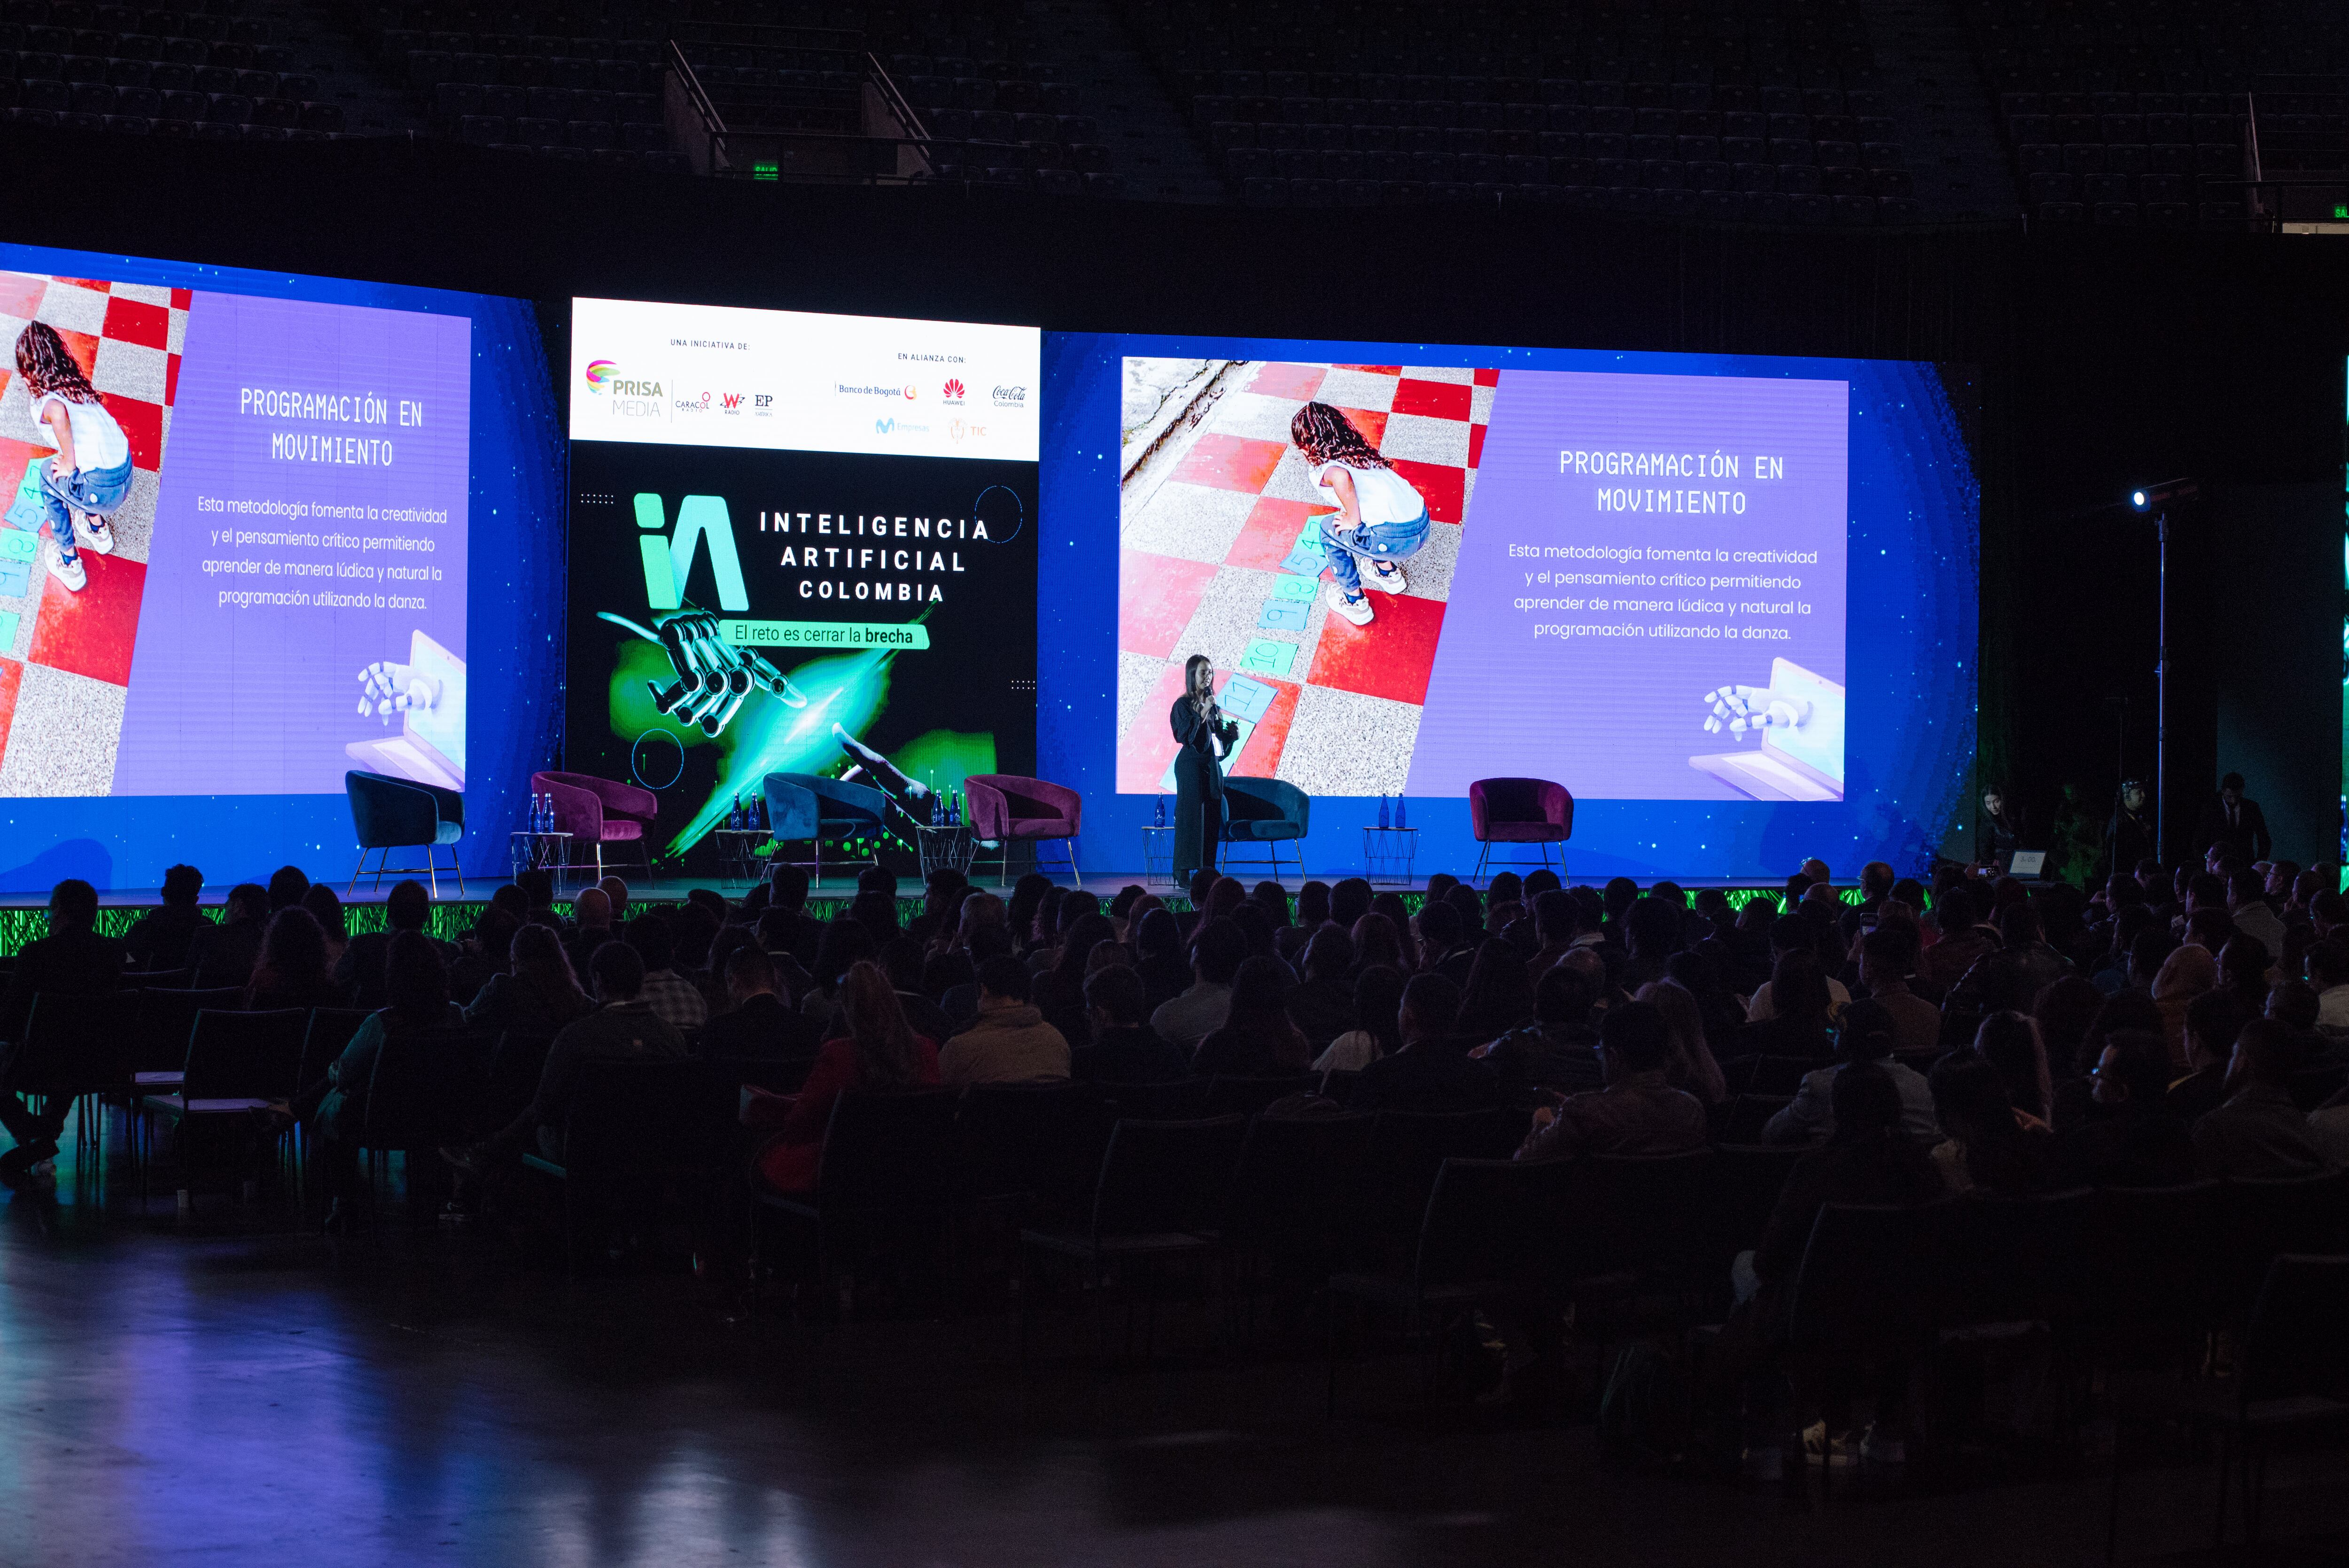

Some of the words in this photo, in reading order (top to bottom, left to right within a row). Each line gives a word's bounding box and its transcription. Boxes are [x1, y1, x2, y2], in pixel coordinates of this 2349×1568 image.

[755, 166, 778, 176] SALID
[2336, 209, 2349, 217] SAL
[691, 340, 734, 349] INICIATIVA
[911, 354, 944, 362] ALIANZA
[614, 380, 663, 397] PRISA
[839, 385, 862, 394] Banco
[874, 387, 901, 397] Bogotá
[241, 388, 386, 424] PROGRAMACIÓN
[400, 401, 421, 427] EN
[613, 400, 661, 417] MEDIA
[676, 400, 709, 409] CARACOL
[723, 392, 740, 409] W
[755, 395, 773, 407] EP
[897, 423, 929, 432] Empresas
[971, 427, 987, 436] TIC
[272, 433, 392, 466] MOVIMIENTO
[1561, 450, 1738, 478] PROGRAMACIÓN
[1756, 457, 1782, 479] EN
[199, 497, 224, 512] Esta
[228, 500, 308, 520] metodología
[311, 502, 364, 519] fomenta
[368, 505, 378, 520] la
[382, 507, 447, 523] creatividad
[1598, 489, 1745, 514] MOVIMIENTO
[14, 504, 38, 524] 5
[760, 512, 988, 539] INTELIGENCIA
[8, 538, 35, 553] 8
[211, 530, 218, 546] y
[222, 528, 232, 542] el
[236, 530, 319, 547] pensamiento
[322, 533, 359, 548] crítico
[363, 536, 435, 553] permitiendo
[781, 546, 964, 571] ARTIFICIAL
[1291, 554, 1317, 570] 5
[1509, 544, 1539, 557] Esta
[1545, 546, 1641, 563] metodología
[1647, 547, 1711, 561] fomenta
[1716, 549, 1728, 561] la
[1734, 550, 1817, 563] creatividad
[202, 559, 261, 577] aprender
[264, 559, 280, 574] de
[285, 563, 333, 576] manera
[337, 562, 373, 578] lúdica
[377, 567, 384, 583] y
[388, 566, 428, 580] natural
[432, 567, 442, 581] la
[1525, 573, 1533, 587] y
[1538, 570, 1550, 583] el
[1556, 572, 1656, 587] pensamiento
[1660, 573, 1706, 586] crítico
[1711, 574, 1801, 590] permitiendo
[800, 581, 943, 601] COLOMBIA
[1284, 582, 1314, 595] 8
[219, 590, 309, 608] programación
[313, 591, 371, 607] utilizando
[374, 593, 385, 608] la
[389, 594, 427, 609] danza.
[1514, 597, 1585, 612] aprender
[1589, 597, 1609, 610] de
[1614, 600, 1673, 611] manera
[1679, 599, 1723, 612] lúdica
[1728, 603, 1736, 616] y
[1741, 601, 1793, 613] natural
[1798, 601, 1811, 614] la
[1267, 609, 1297, 621] 9
[736, 625, 747, 640] El
[752, 628, 779, 640] reto
[784, 629, 799, 641] es
[804, 630, 845, 642] cerrar
[850, 627, 861, 642] la
[866, 628, 913, 643] brecha
[1535, 623, 1644, 639] programación
[1649, 624, 1720, 638] utilizando
[1725, 625, 1737, 638] la
[1742, 626, 1791, 639] danza.
[1250, 643, 1278, 668] 10
[1225, 682, 1259, 712] 11
